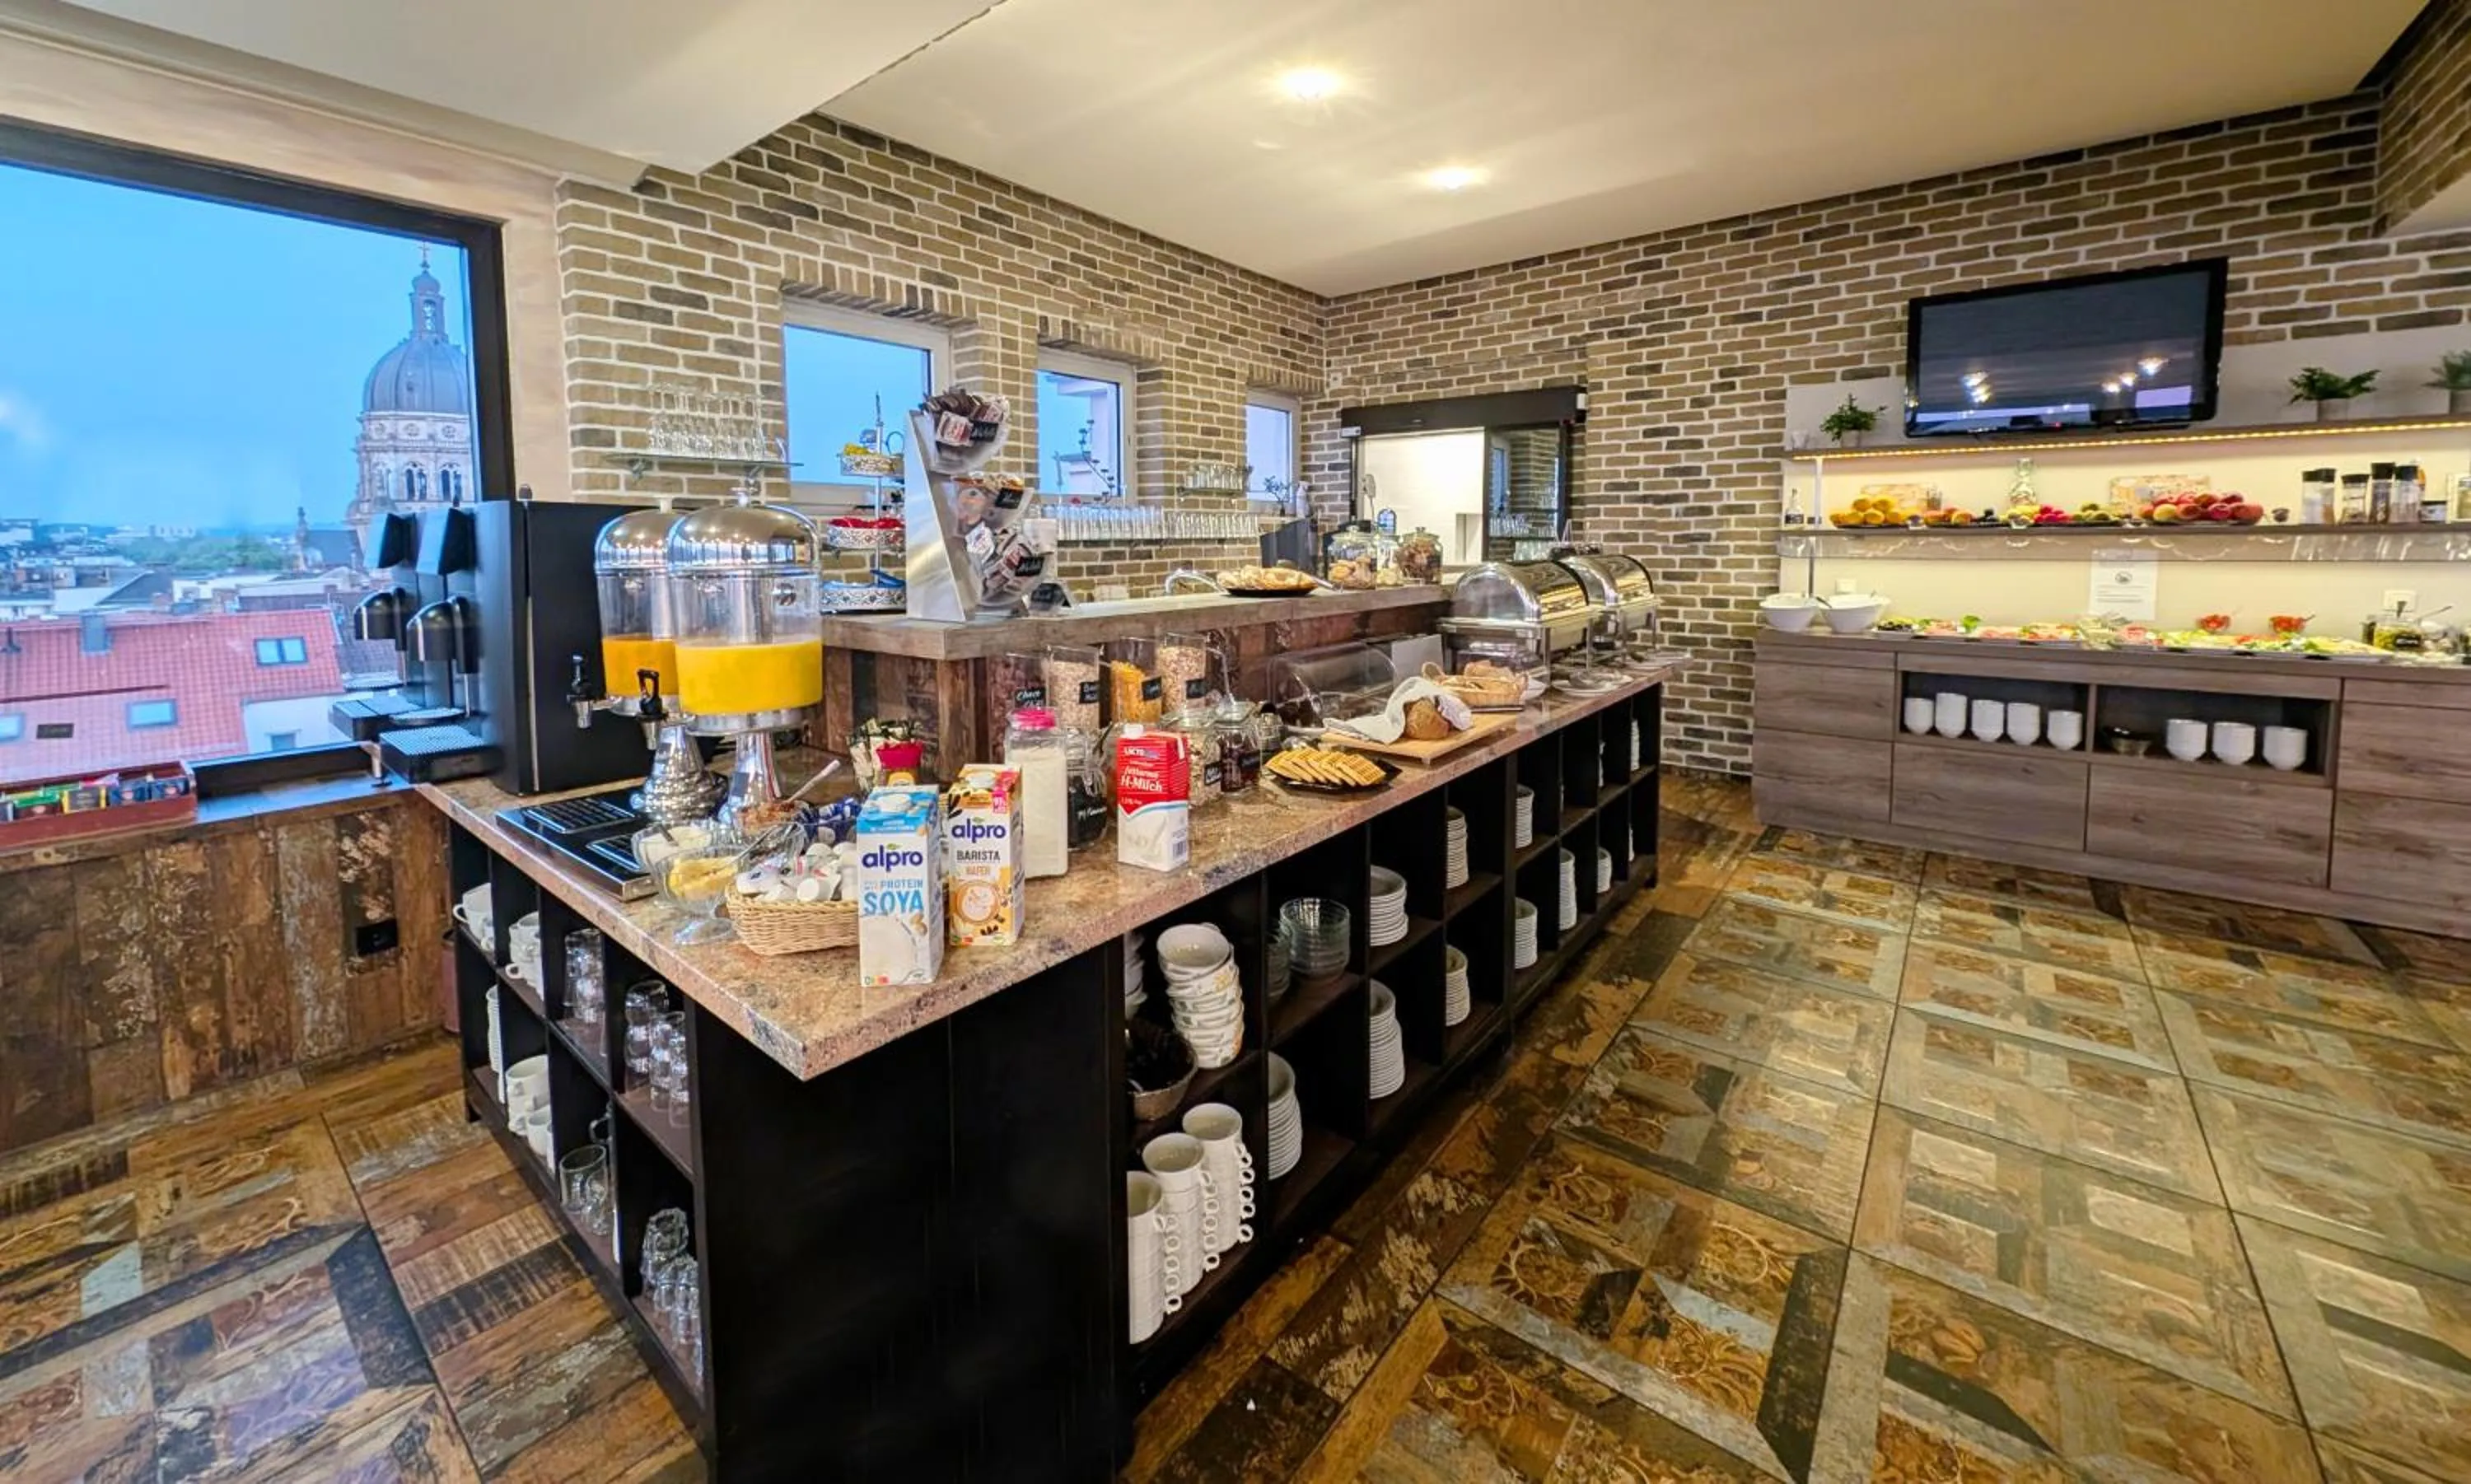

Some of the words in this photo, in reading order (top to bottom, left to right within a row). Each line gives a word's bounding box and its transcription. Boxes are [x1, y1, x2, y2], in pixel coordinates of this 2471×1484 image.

[1121, 775, 1163, 792] H-Milch
[951, 818, 1007, 843] alpro
[862, 844, 923, 872] alpro
[956, 850, 1001, 861] BARISTA
[880, 879, 923, 889] PROTEIN
[864, 889, 924, 916] SOYA
